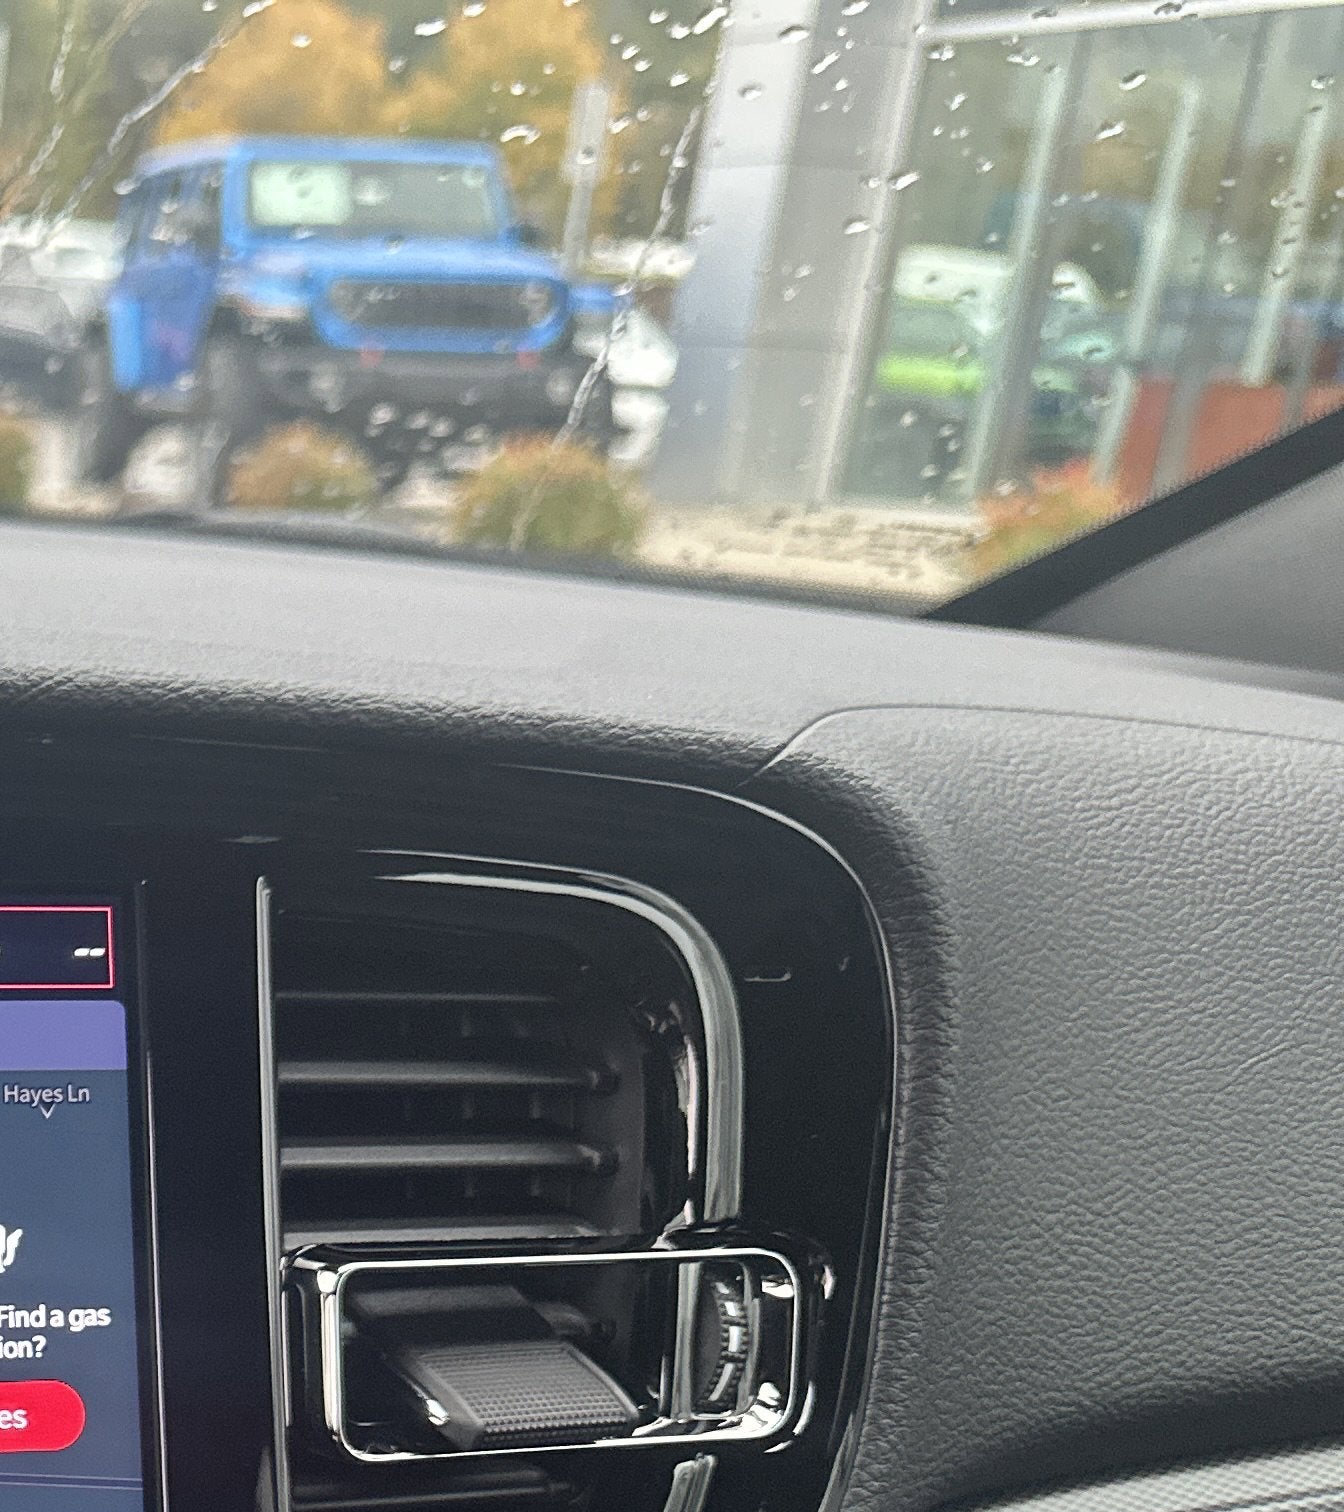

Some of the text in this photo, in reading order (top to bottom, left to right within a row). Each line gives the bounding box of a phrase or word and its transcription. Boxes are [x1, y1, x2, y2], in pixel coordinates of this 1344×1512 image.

[3, 1085, 91, 1108] Hayes Ln
[50, 1310, 63, 1327] a
[68, 1307, 111, 1331] gas
